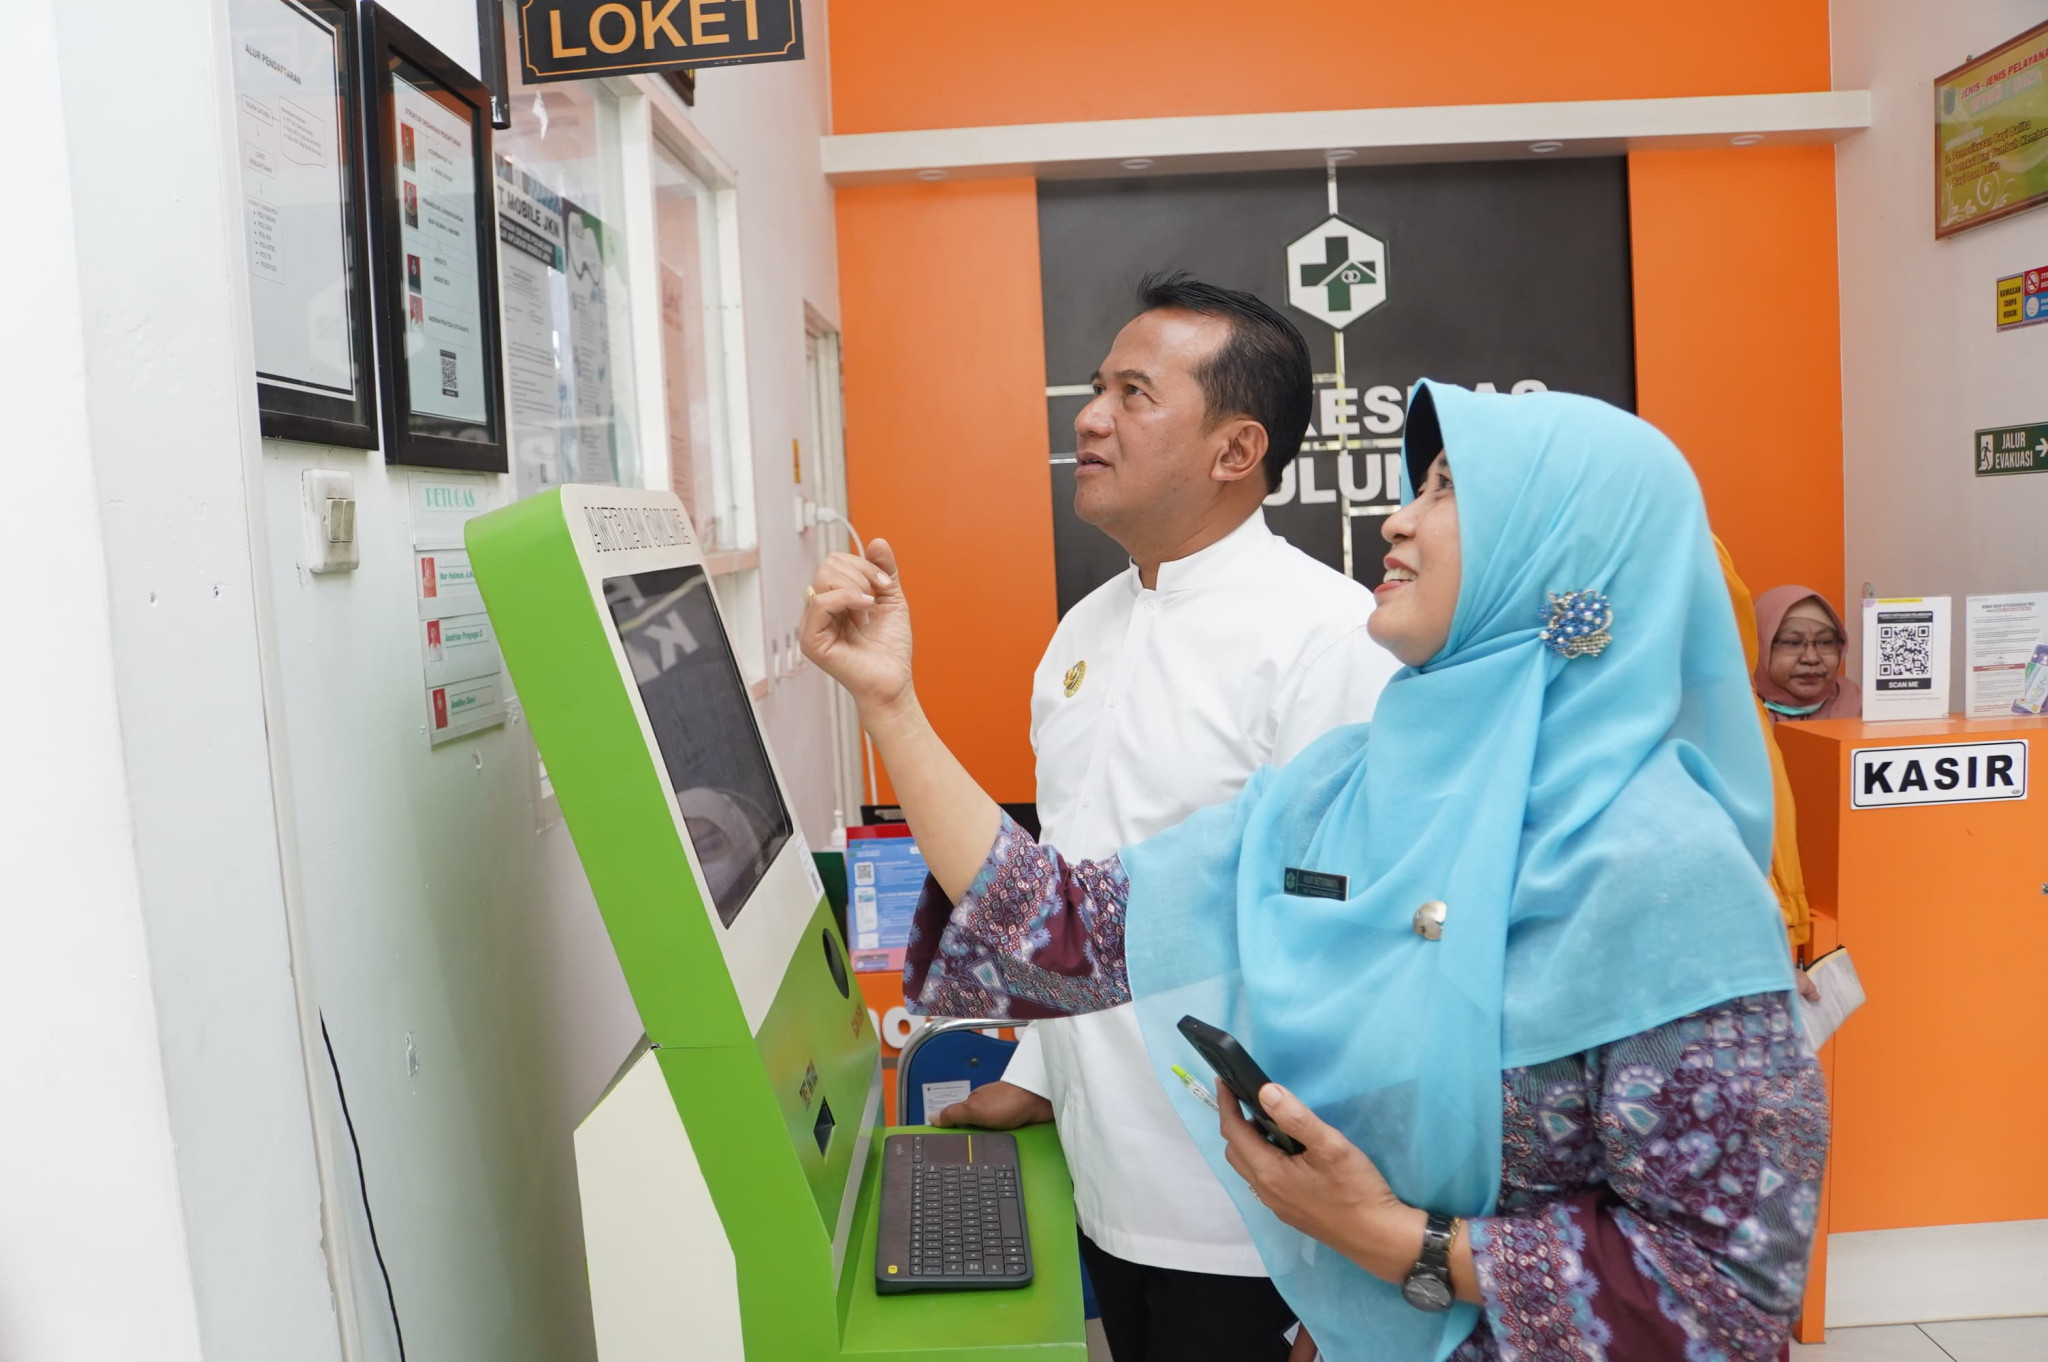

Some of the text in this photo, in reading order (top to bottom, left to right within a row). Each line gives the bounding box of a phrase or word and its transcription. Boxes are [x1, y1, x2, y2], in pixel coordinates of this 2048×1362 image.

[549, 0, 759, 59] LOKET
[245, 44, 302, 85] ALUR PENDAFTARAN
[1961, 82, 1981, 99] JENIS
[1985, 70, 2007, 88] JENIS
[508, 193, 541, 227] MOBILE
[544, 217, 560, 239] JKN
[2000, 286, 2021, 298] KAWASAN
[2002, 431, 2026, 449] JALUR
[1996, 451, 2033, 469] EVAKUASI
[425, 487, 476, 508] PETUGAS
[1888, 681, 1906, 689] SCAN
[1863, 754, 2014, 795] KASIR
